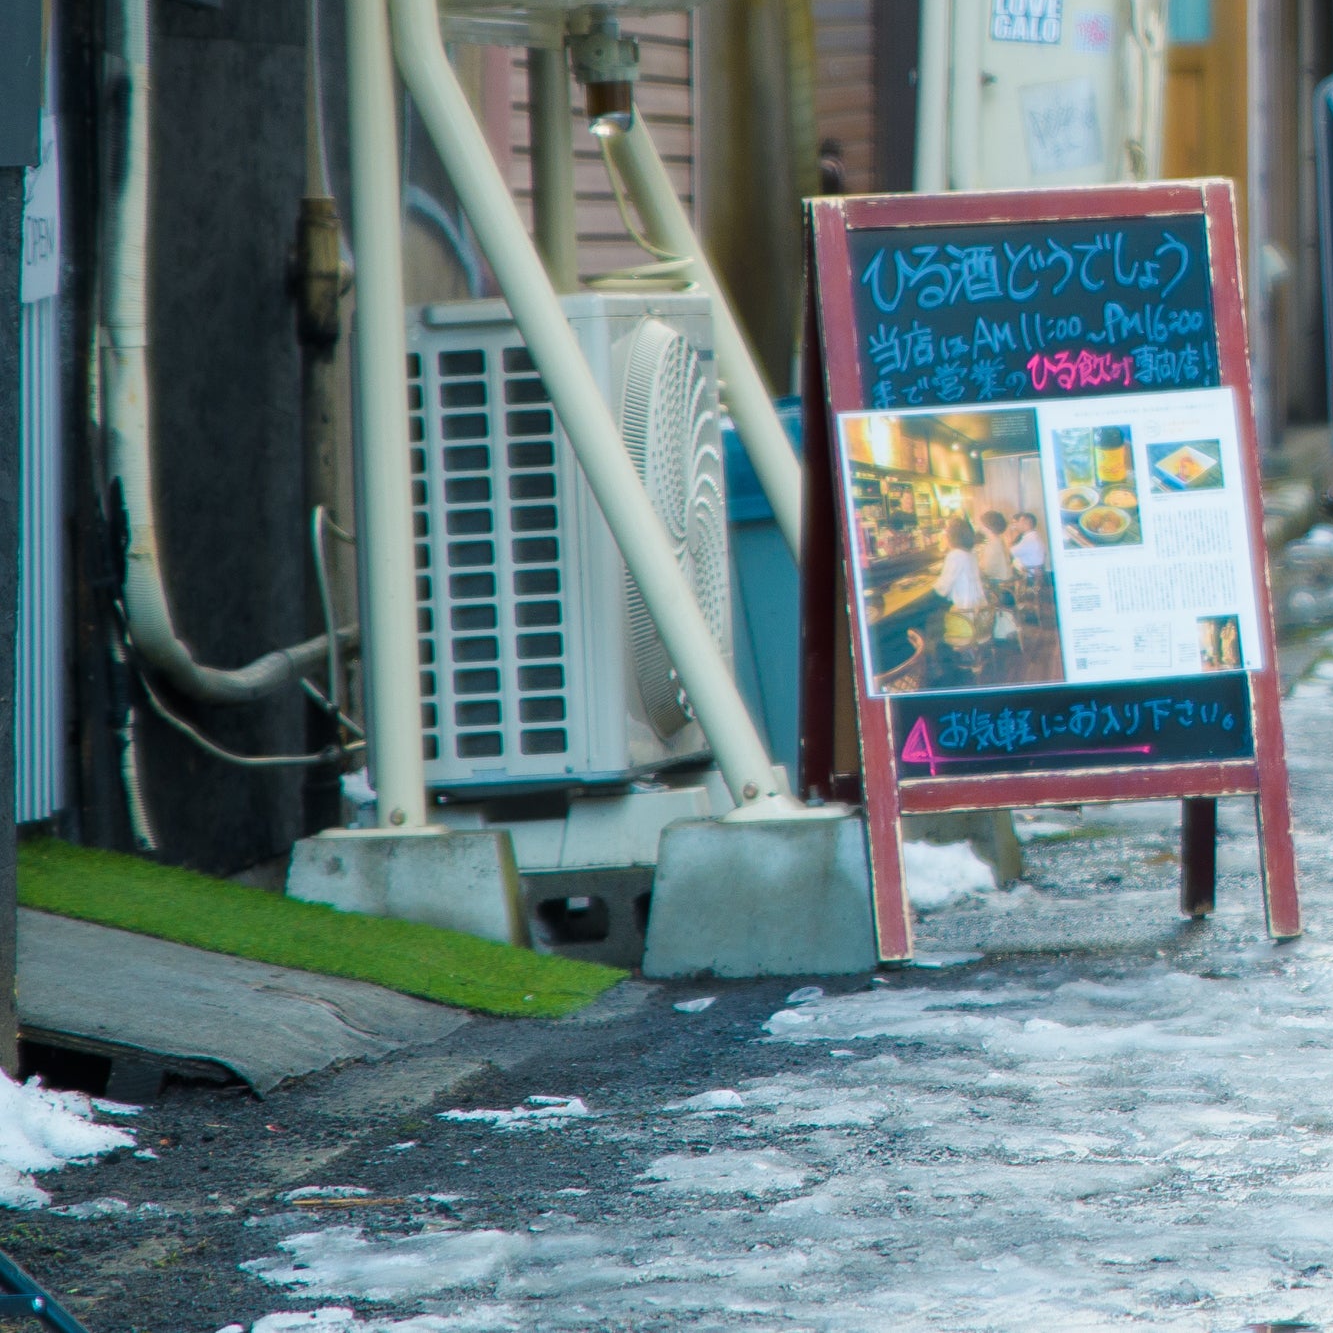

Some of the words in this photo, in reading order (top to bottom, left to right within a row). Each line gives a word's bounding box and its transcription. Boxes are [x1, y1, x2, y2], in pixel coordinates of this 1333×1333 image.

[861, 231, 1191, 313] ひる酒どうでしょう
